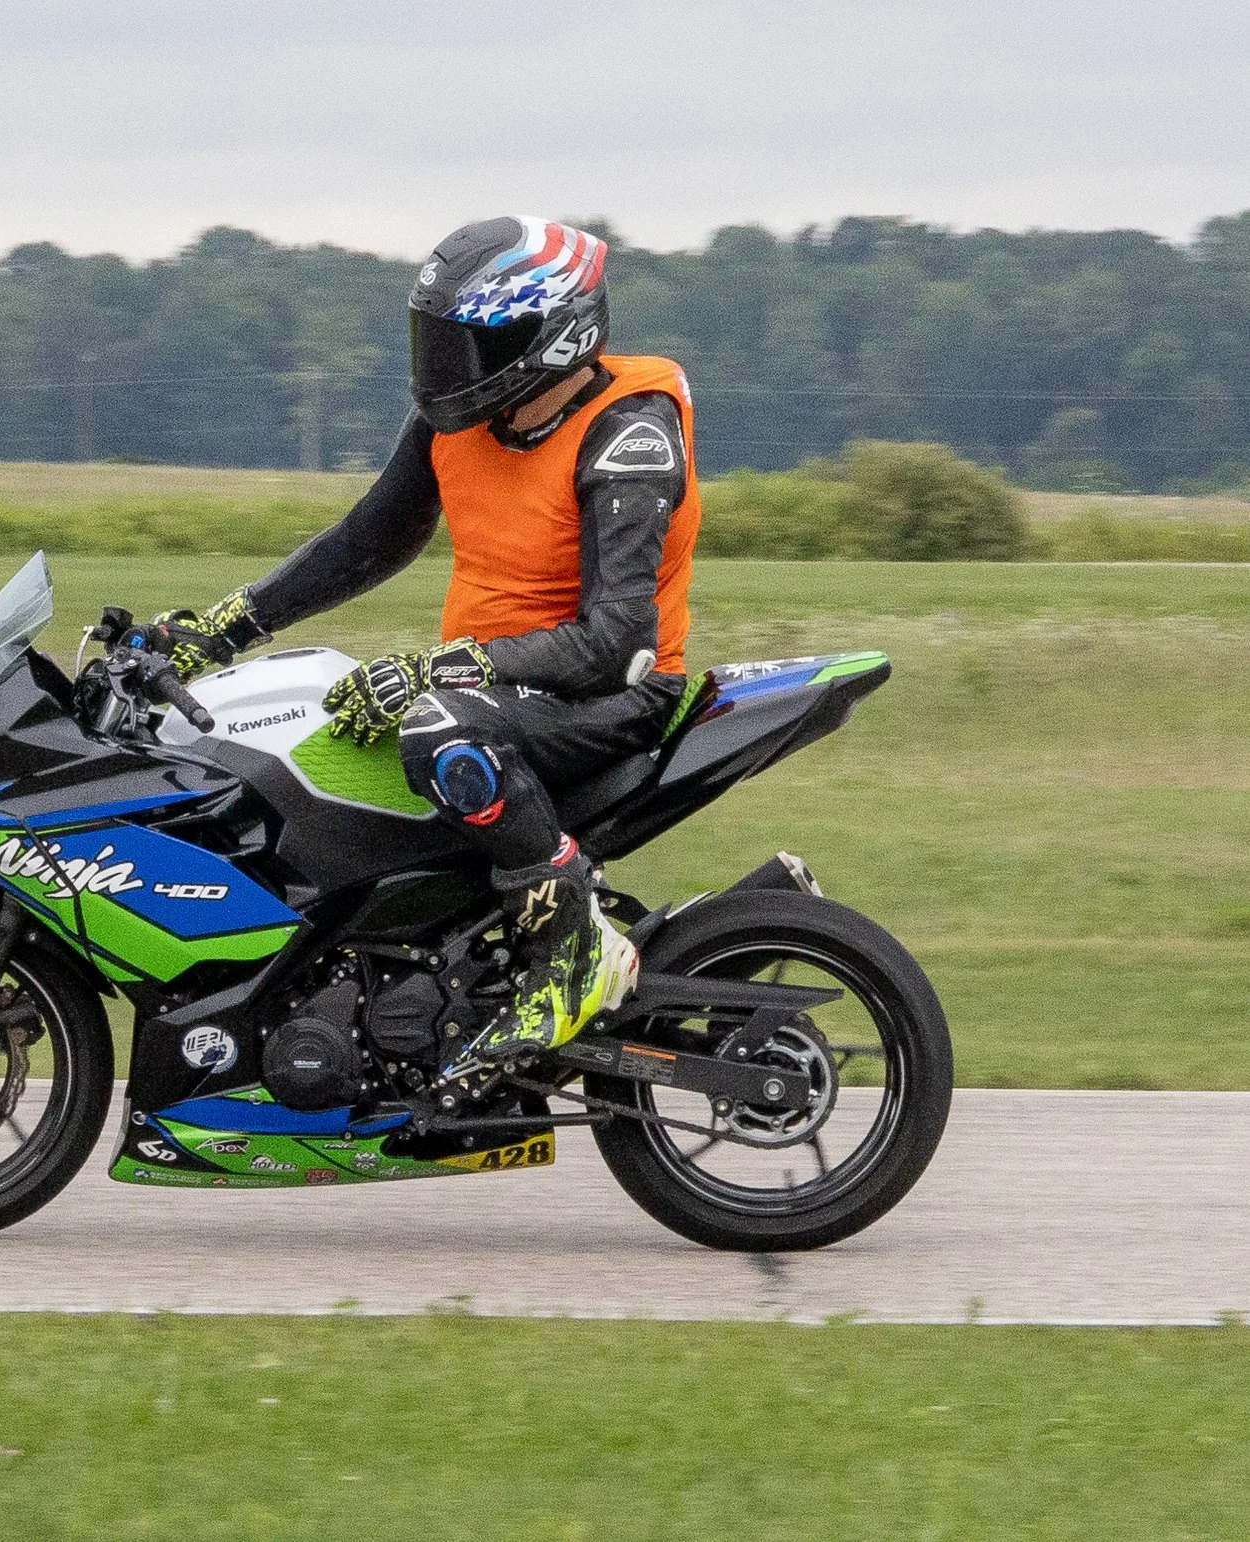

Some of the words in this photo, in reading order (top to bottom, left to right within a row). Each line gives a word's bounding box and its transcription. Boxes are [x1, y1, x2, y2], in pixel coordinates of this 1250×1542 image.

[610, 437, 668, 457] RST
[432, 665, 480, 677] RST
[226, 705, 307, 735] Kawasaki
[153, 882, 229, 900] 400
[478, 1140, 551, 1170] 428
